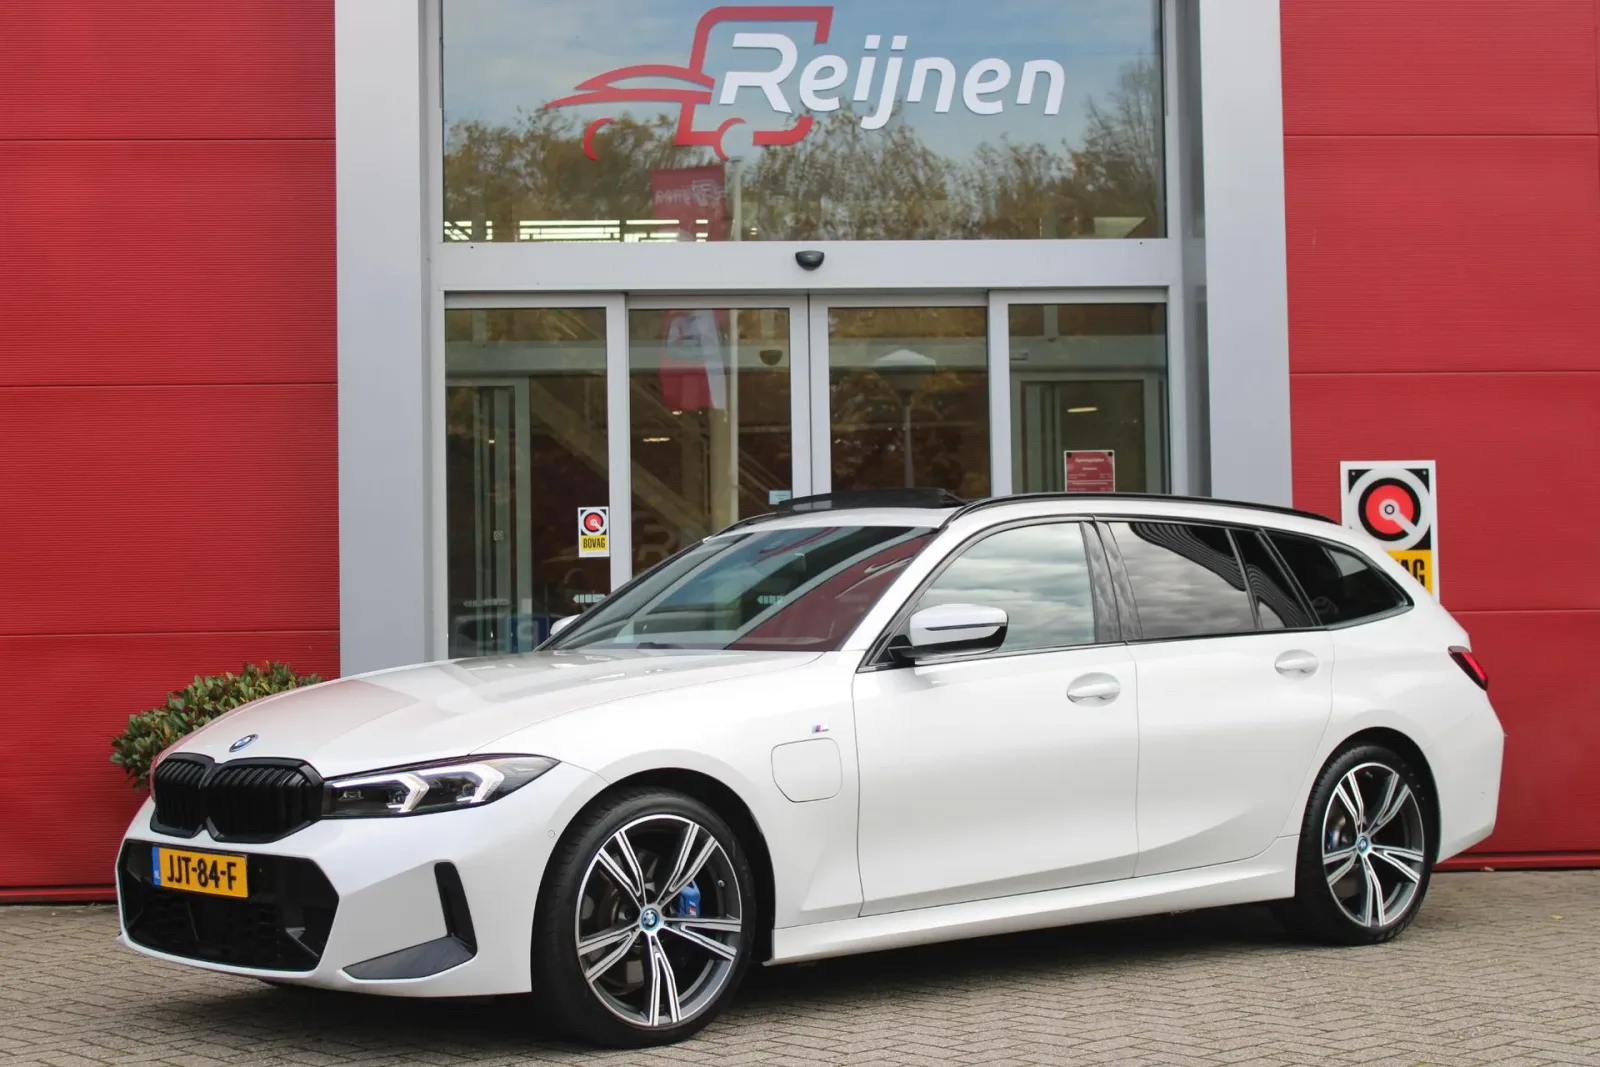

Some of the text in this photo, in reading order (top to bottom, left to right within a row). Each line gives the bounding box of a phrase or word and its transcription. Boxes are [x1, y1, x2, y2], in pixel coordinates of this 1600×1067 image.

[719, 33, 1065, 129] Reijnen
[583, 537, 606, 549] BOVAG
[167, 854, 237, 890] JJT-84-F
